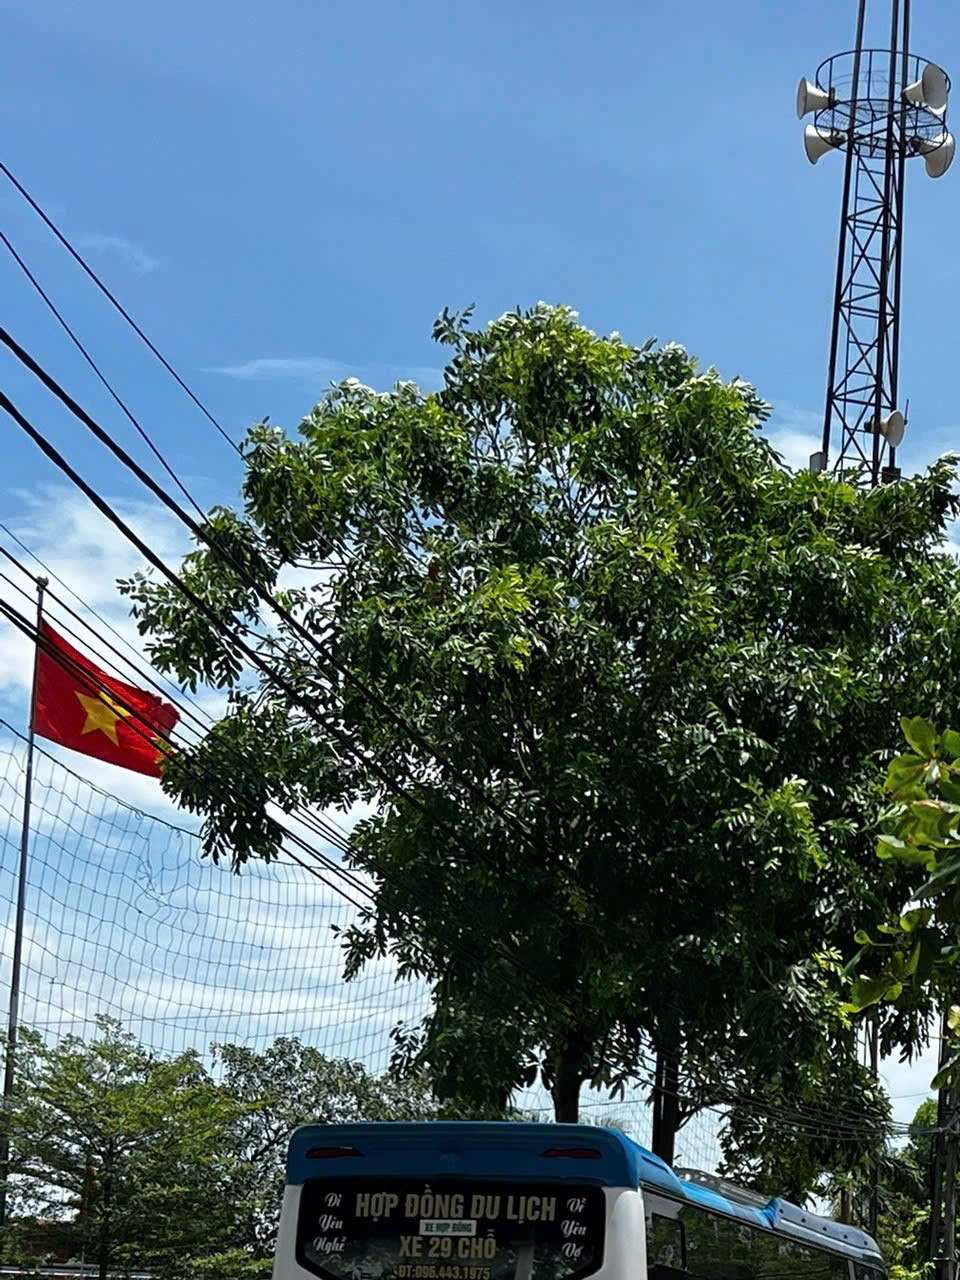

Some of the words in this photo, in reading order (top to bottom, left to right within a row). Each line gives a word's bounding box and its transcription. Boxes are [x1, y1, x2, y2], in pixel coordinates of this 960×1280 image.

[355, 1192, 399, 1222] HỢP
[404, 1184, 465, 1219] ĐỒNG
[470, 1195, 501, 1220] DU
[506, 1196, 557, 1225] LỊCH
[424, 1223, 435, 1233] XE
[399, 1235, 423, 1258] XE
[428, 1237, 451, 1259] 29
[458, 1229, 497, 1260] CHỖ
